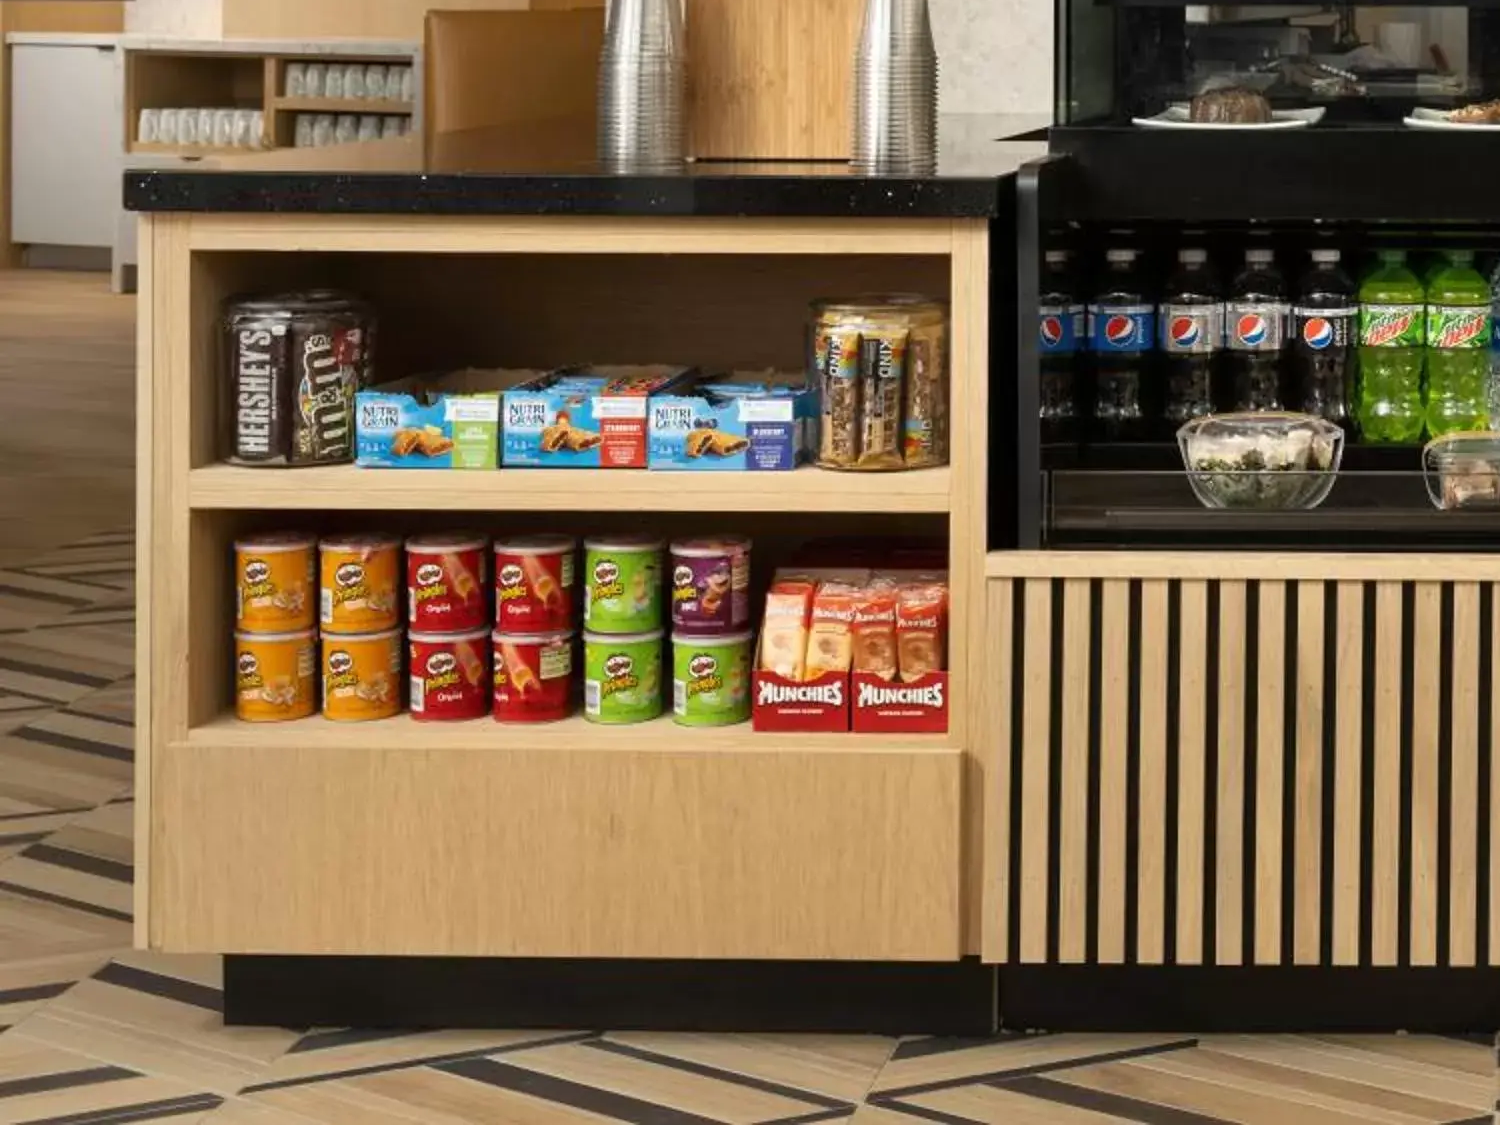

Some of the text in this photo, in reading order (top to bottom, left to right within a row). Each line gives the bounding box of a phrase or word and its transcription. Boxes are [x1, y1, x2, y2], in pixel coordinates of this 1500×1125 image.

[879, 338, 893, 378] KIND
[238, 329, 271, 454] HERSHEY'S
[509, 403, 545, 415] NUTRI
[509, 414, 545, 425] GRAIN
[655, 408, 692, 419] NUTRI
[757, 680, 843, 707] MUNCHIES
[857, 681, 944, 708] MUNCHIES
